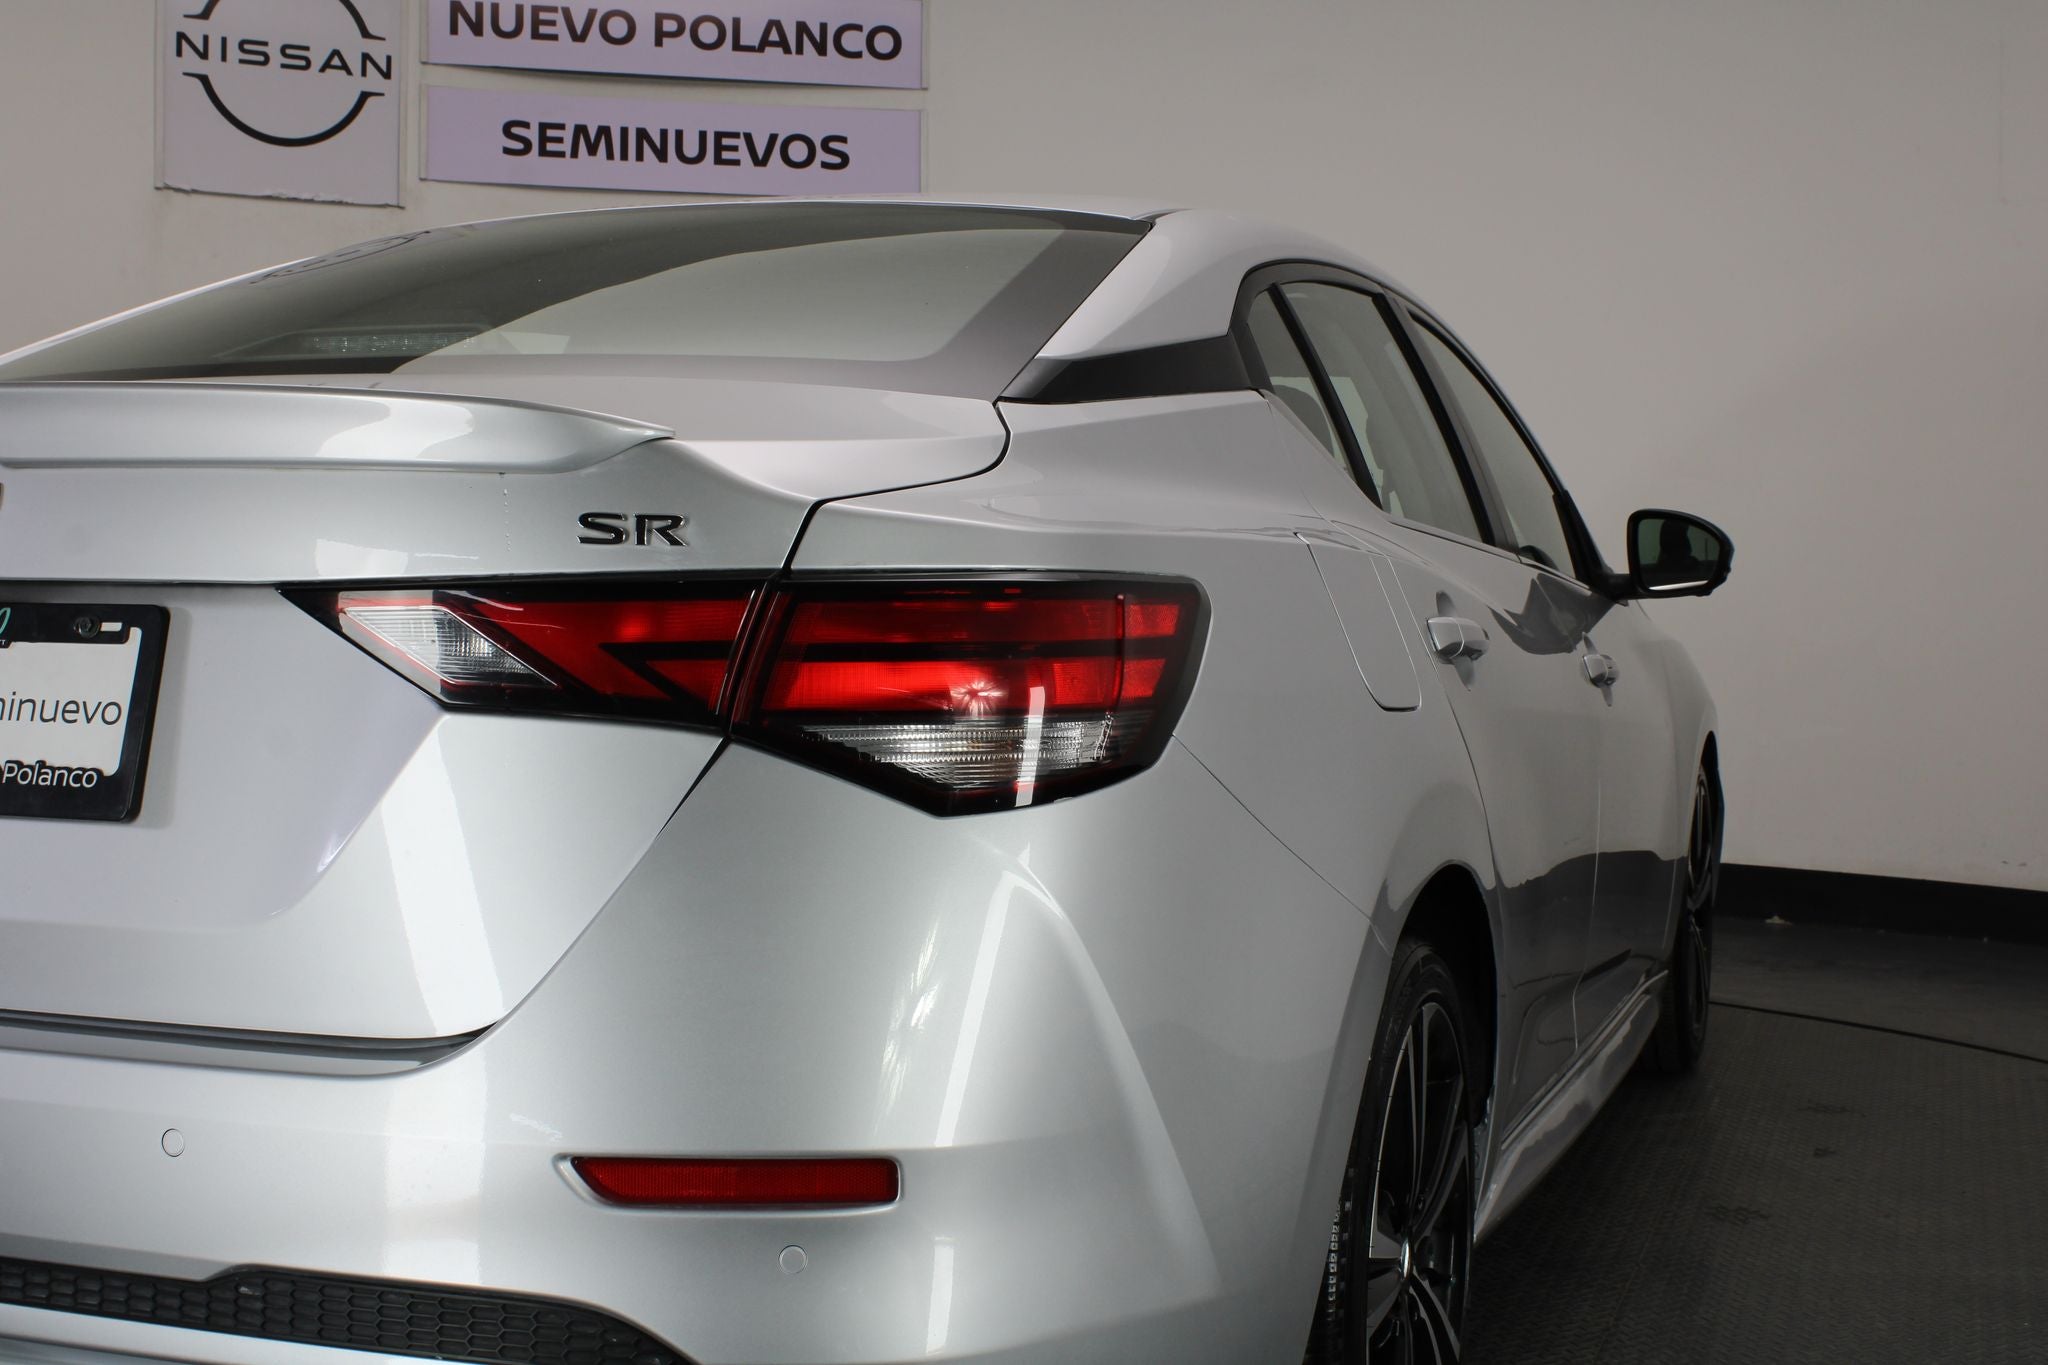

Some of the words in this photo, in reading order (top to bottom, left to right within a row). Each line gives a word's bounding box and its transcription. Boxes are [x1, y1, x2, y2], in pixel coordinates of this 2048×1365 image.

[449, 0, 637, 46] NUEVO
[653, 12, 903, 61] POLANCO
[175, 31, 392, 80] NISSAN
[501, 119, 850, 171] SEMINUEVOS
[577, 511, 688, 546] SR
[0, 691, 122, 725] inuevo
[2, 762, 98, 788] Polanco
